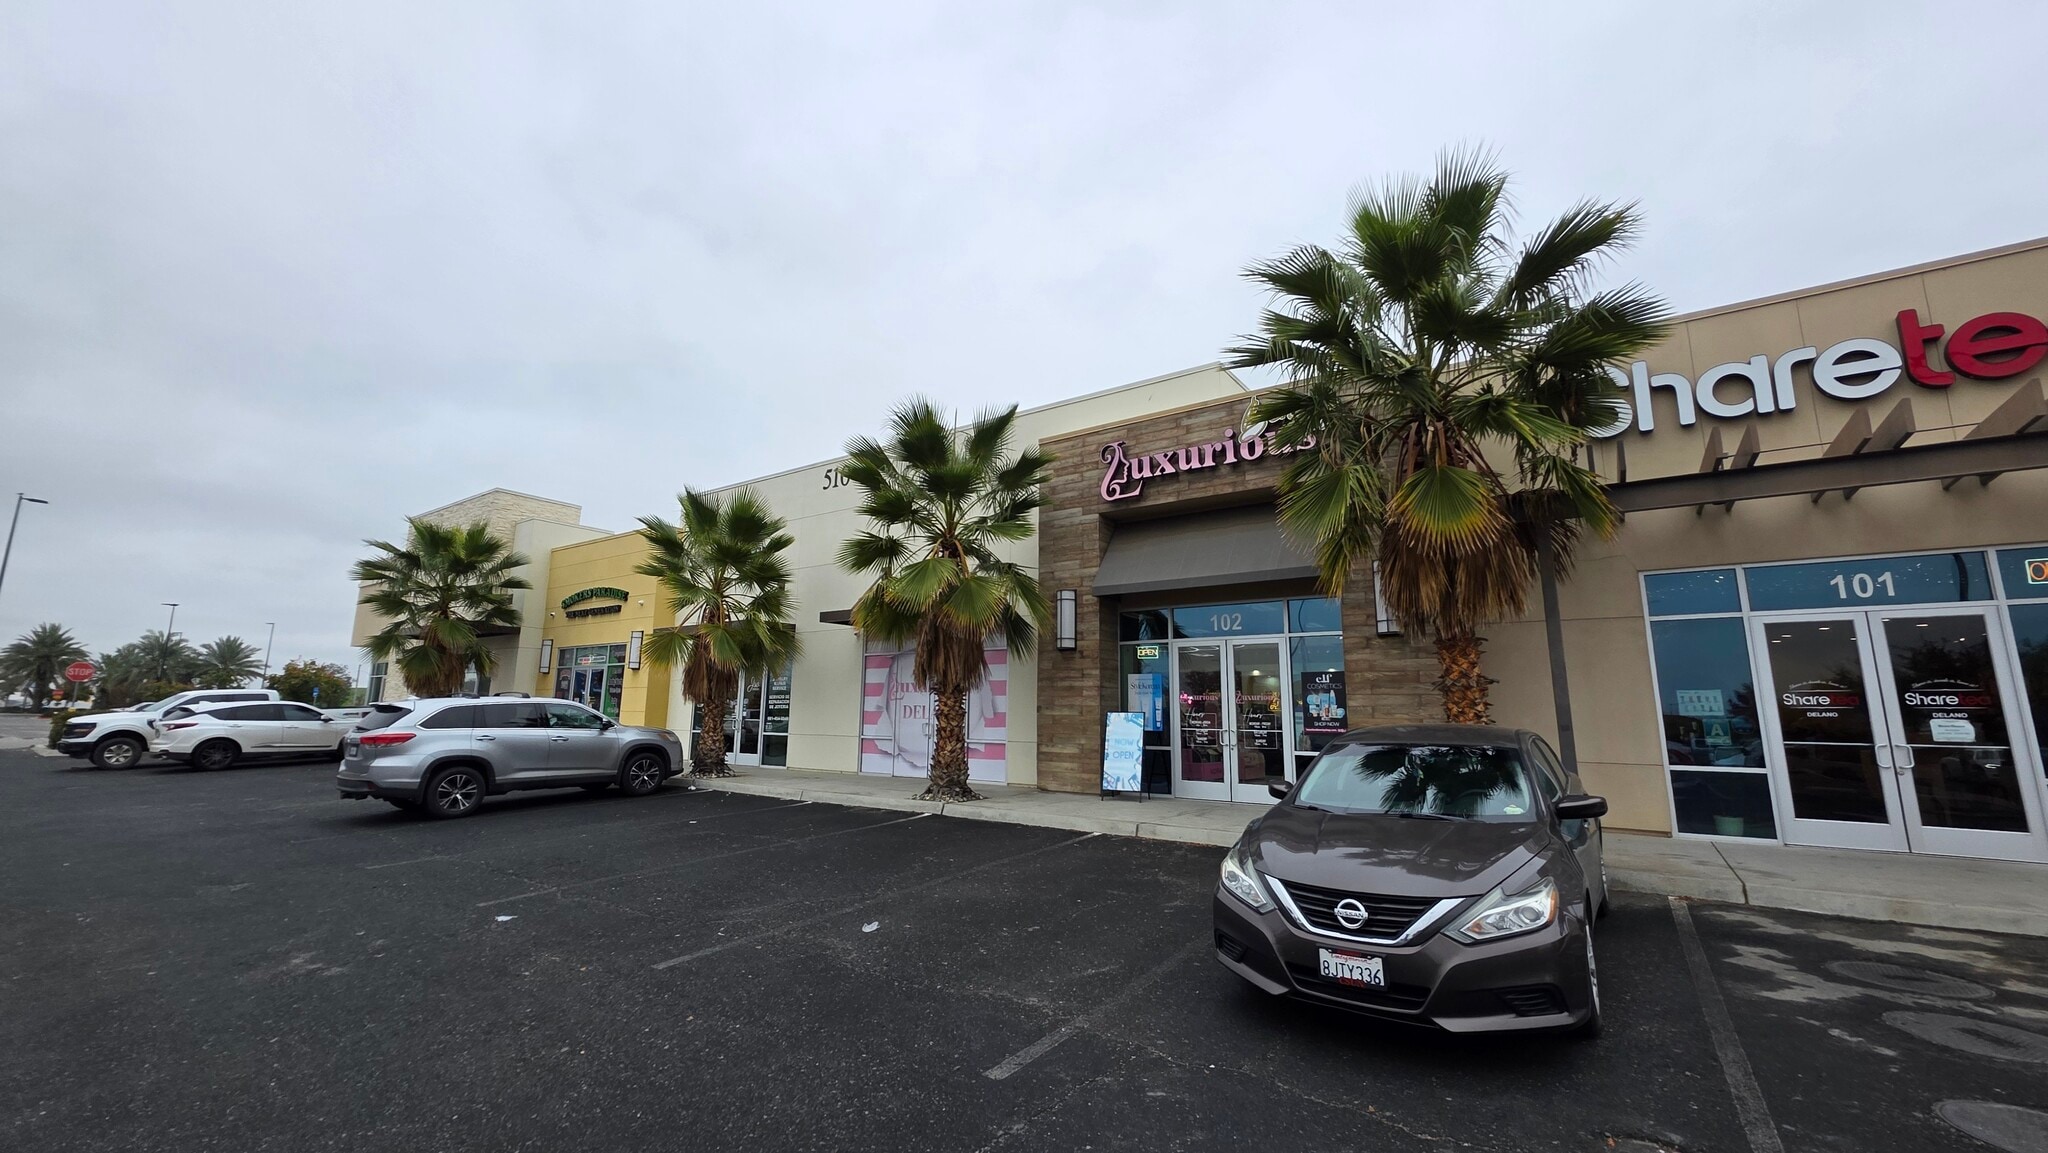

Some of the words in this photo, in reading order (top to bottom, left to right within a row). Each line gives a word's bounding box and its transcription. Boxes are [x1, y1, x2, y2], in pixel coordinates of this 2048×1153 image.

[1830, 571, 1896, 599] 101
[561, 588, 593, 609] SMOKERS
[593, 587, 629, 602] PARADISE
[1210, 613, 1242, 632] 102
[68, 668, 93, 676] STOP
[1782, 693, 1859, 706] Sharetea
[1904, 692, 1991, 706] Sharetea
[1711, 723, 1724, 736] A
[1114, 738, 1134, 746] NOW
[1113, 751, 1134, 760] OPEN
[1336, 910, 1364, 918] NISSAN
[1322, 959, 1382, 986] 8JTY336
